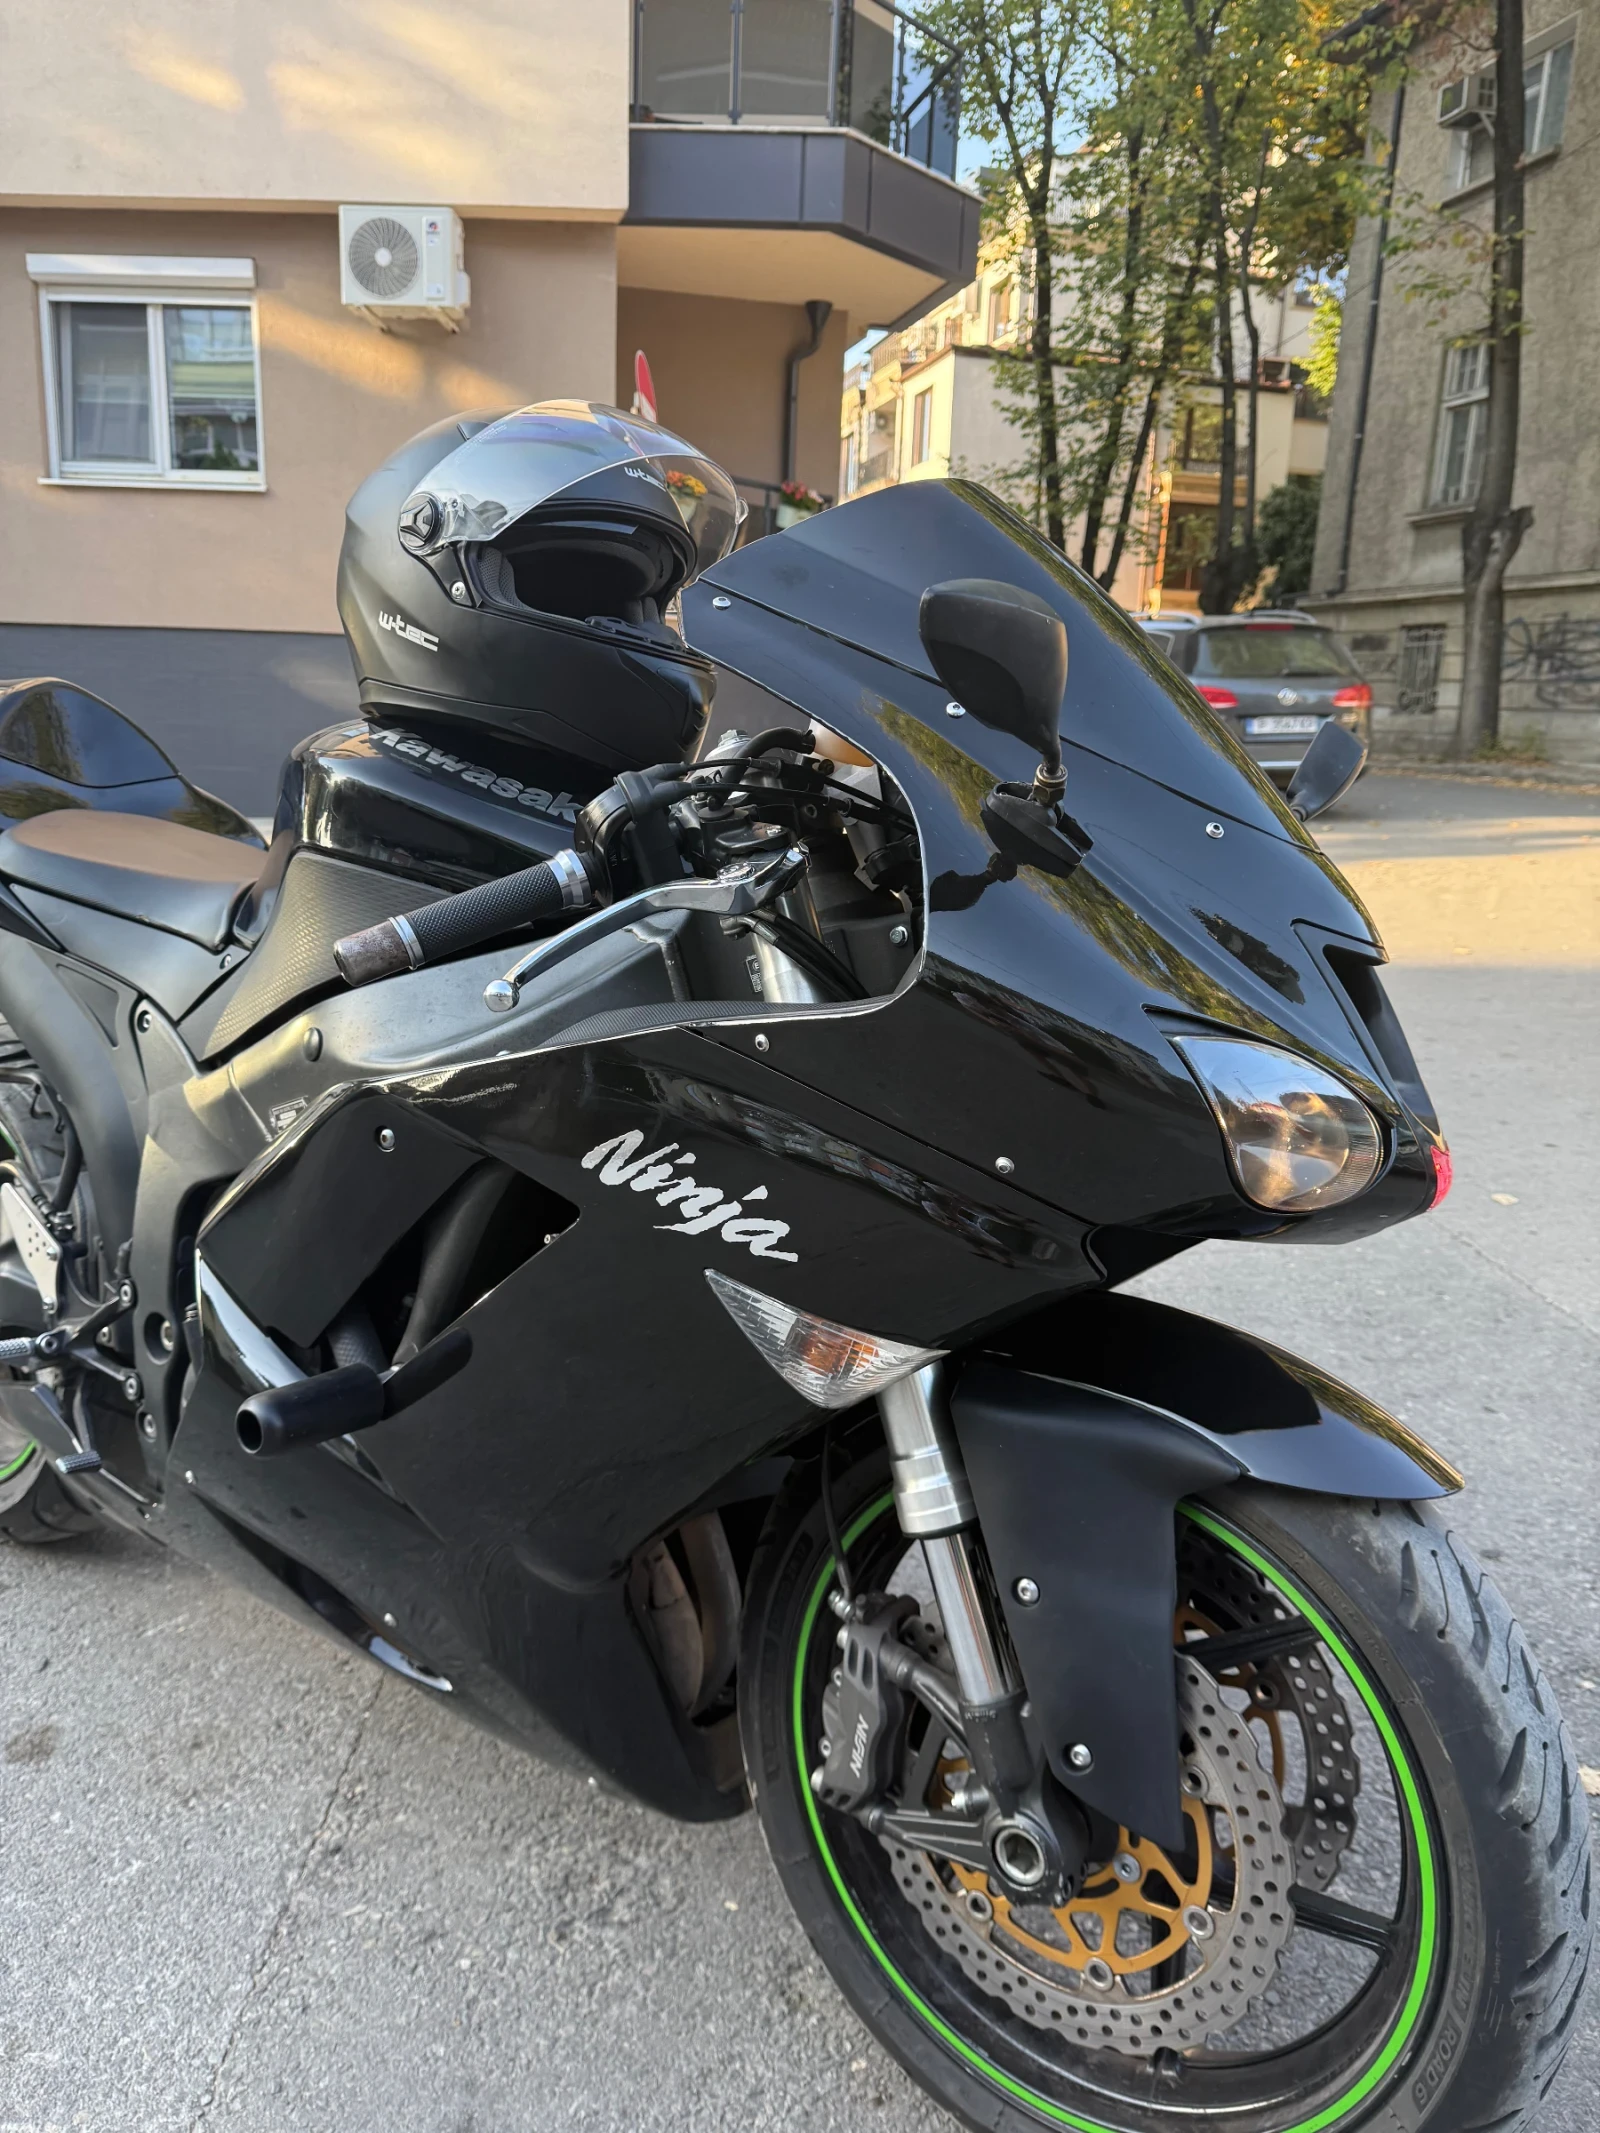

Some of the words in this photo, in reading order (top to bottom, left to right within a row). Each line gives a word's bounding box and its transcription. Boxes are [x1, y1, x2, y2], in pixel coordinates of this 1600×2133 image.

[370, 727, 584, 823] Kawasak
[581, 1129, 799, 1262] Ninja
[1426, 2026, 1457, 2084] ROAD
[1415, 2083, 1428, 2105] 6
